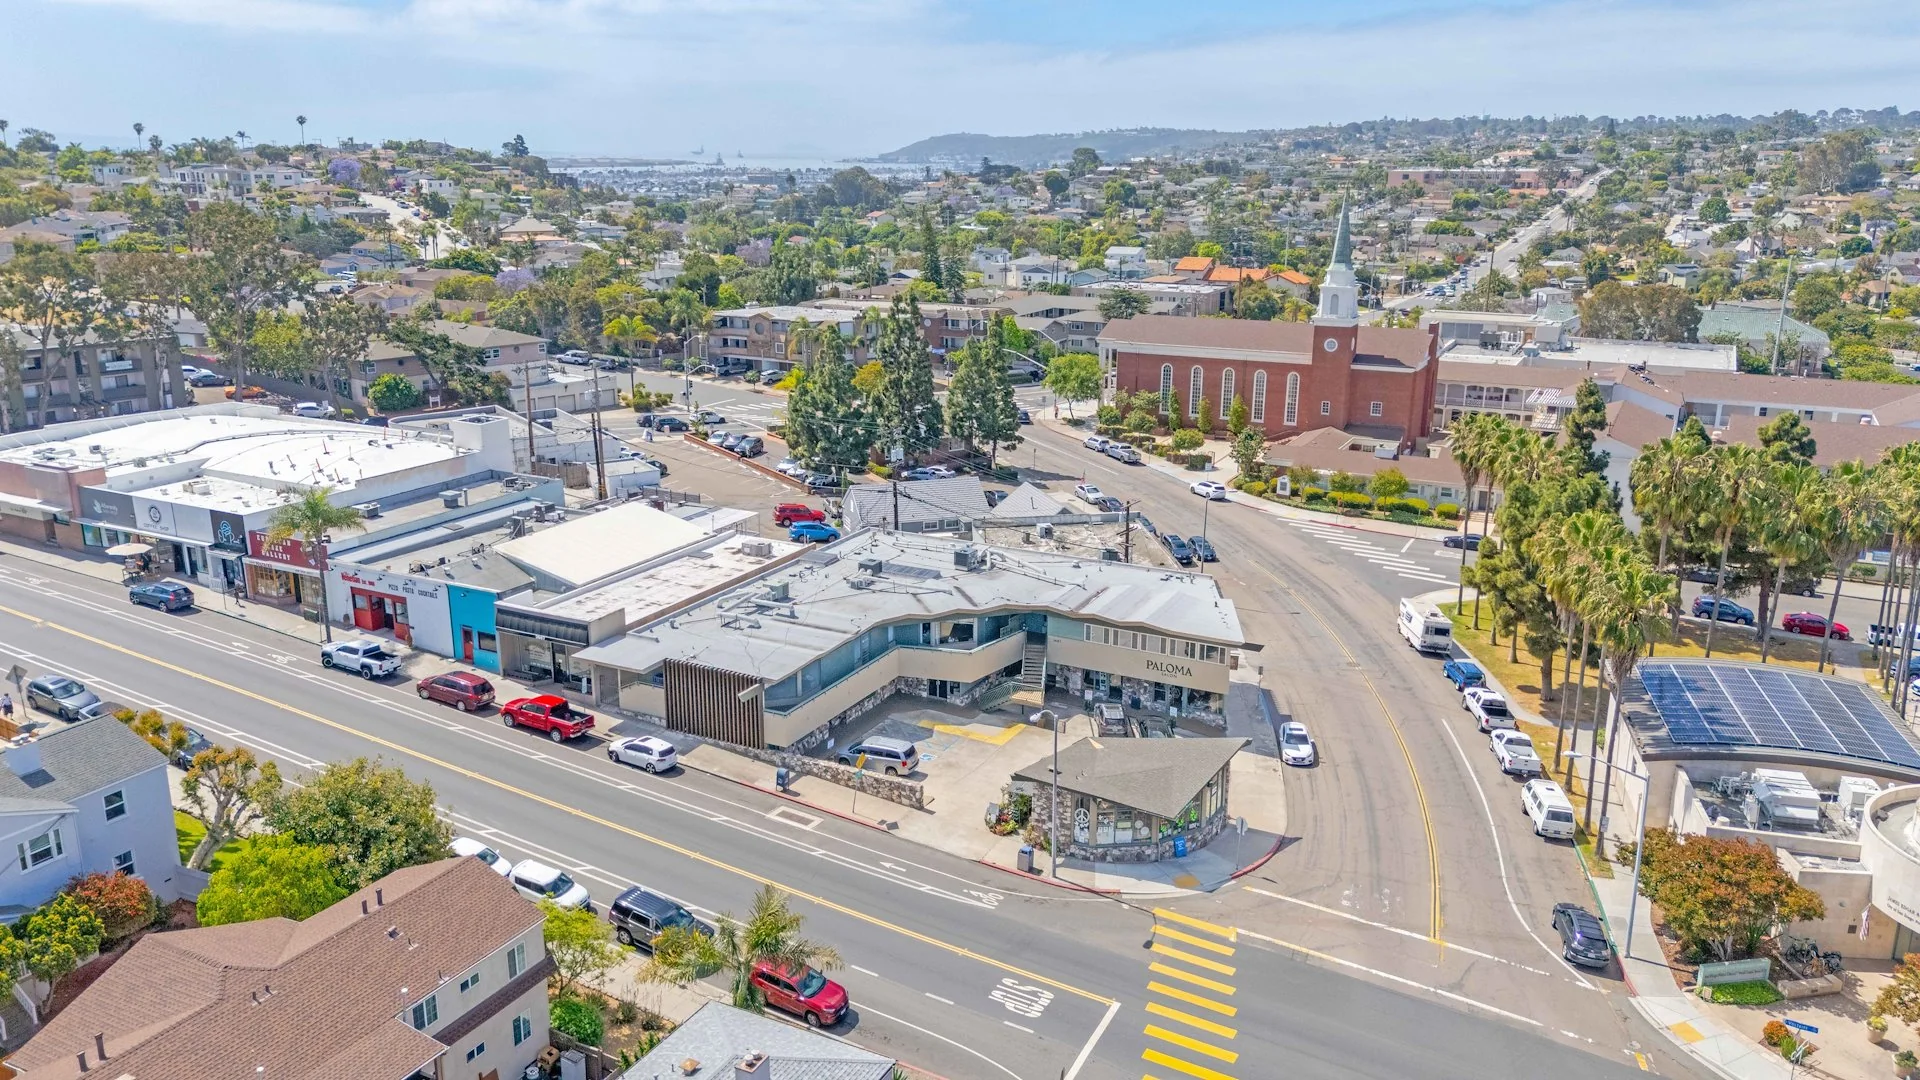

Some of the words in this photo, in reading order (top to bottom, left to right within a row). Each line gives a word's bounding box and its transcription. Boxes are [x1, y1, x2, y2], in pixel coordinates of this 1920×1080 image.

[261, 550, 291, 561] GALLERY
[1146, 660, 1192, 676] PALOMA
[988, 977, 1055, 1018] STOP
